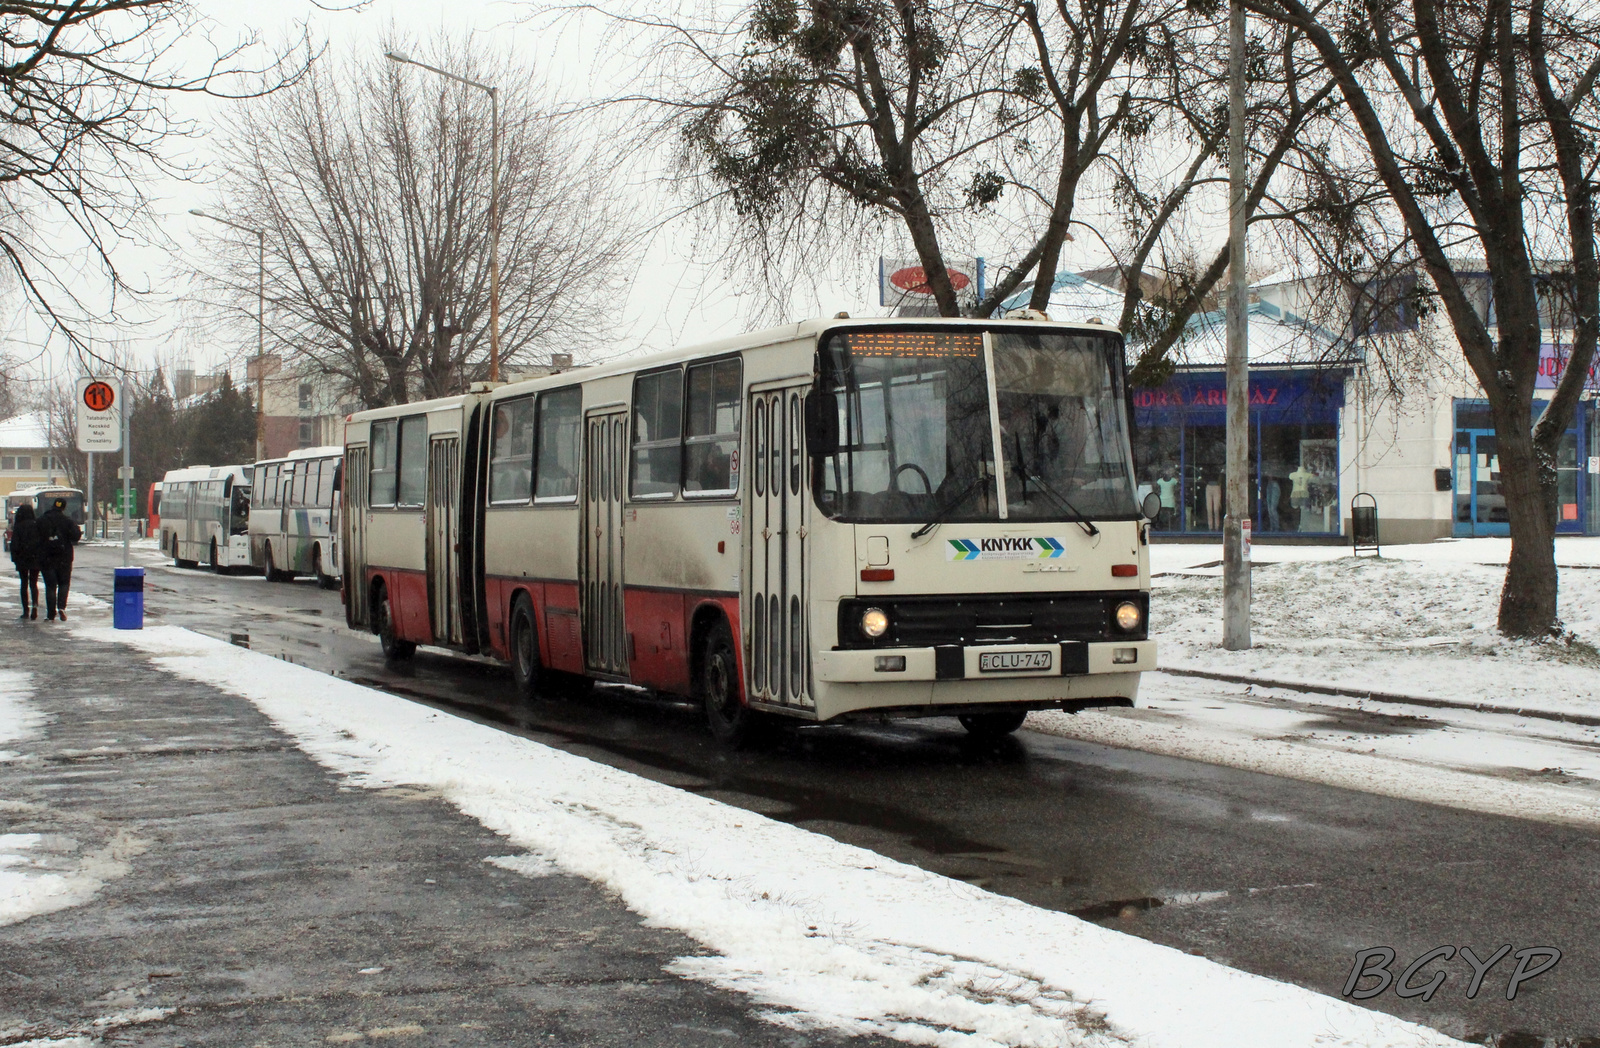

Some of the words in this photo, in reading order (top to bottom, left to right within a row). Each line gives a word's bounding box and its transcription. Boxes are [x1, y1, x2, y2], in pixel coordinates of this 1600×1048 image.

[88, 387, 106, 406] 11
[1193, 385, 1278, 406] ÁRÁZ
[981, 537, 1033, 552] KNYKK
[991, 653, 1049, 668] CLU-747
